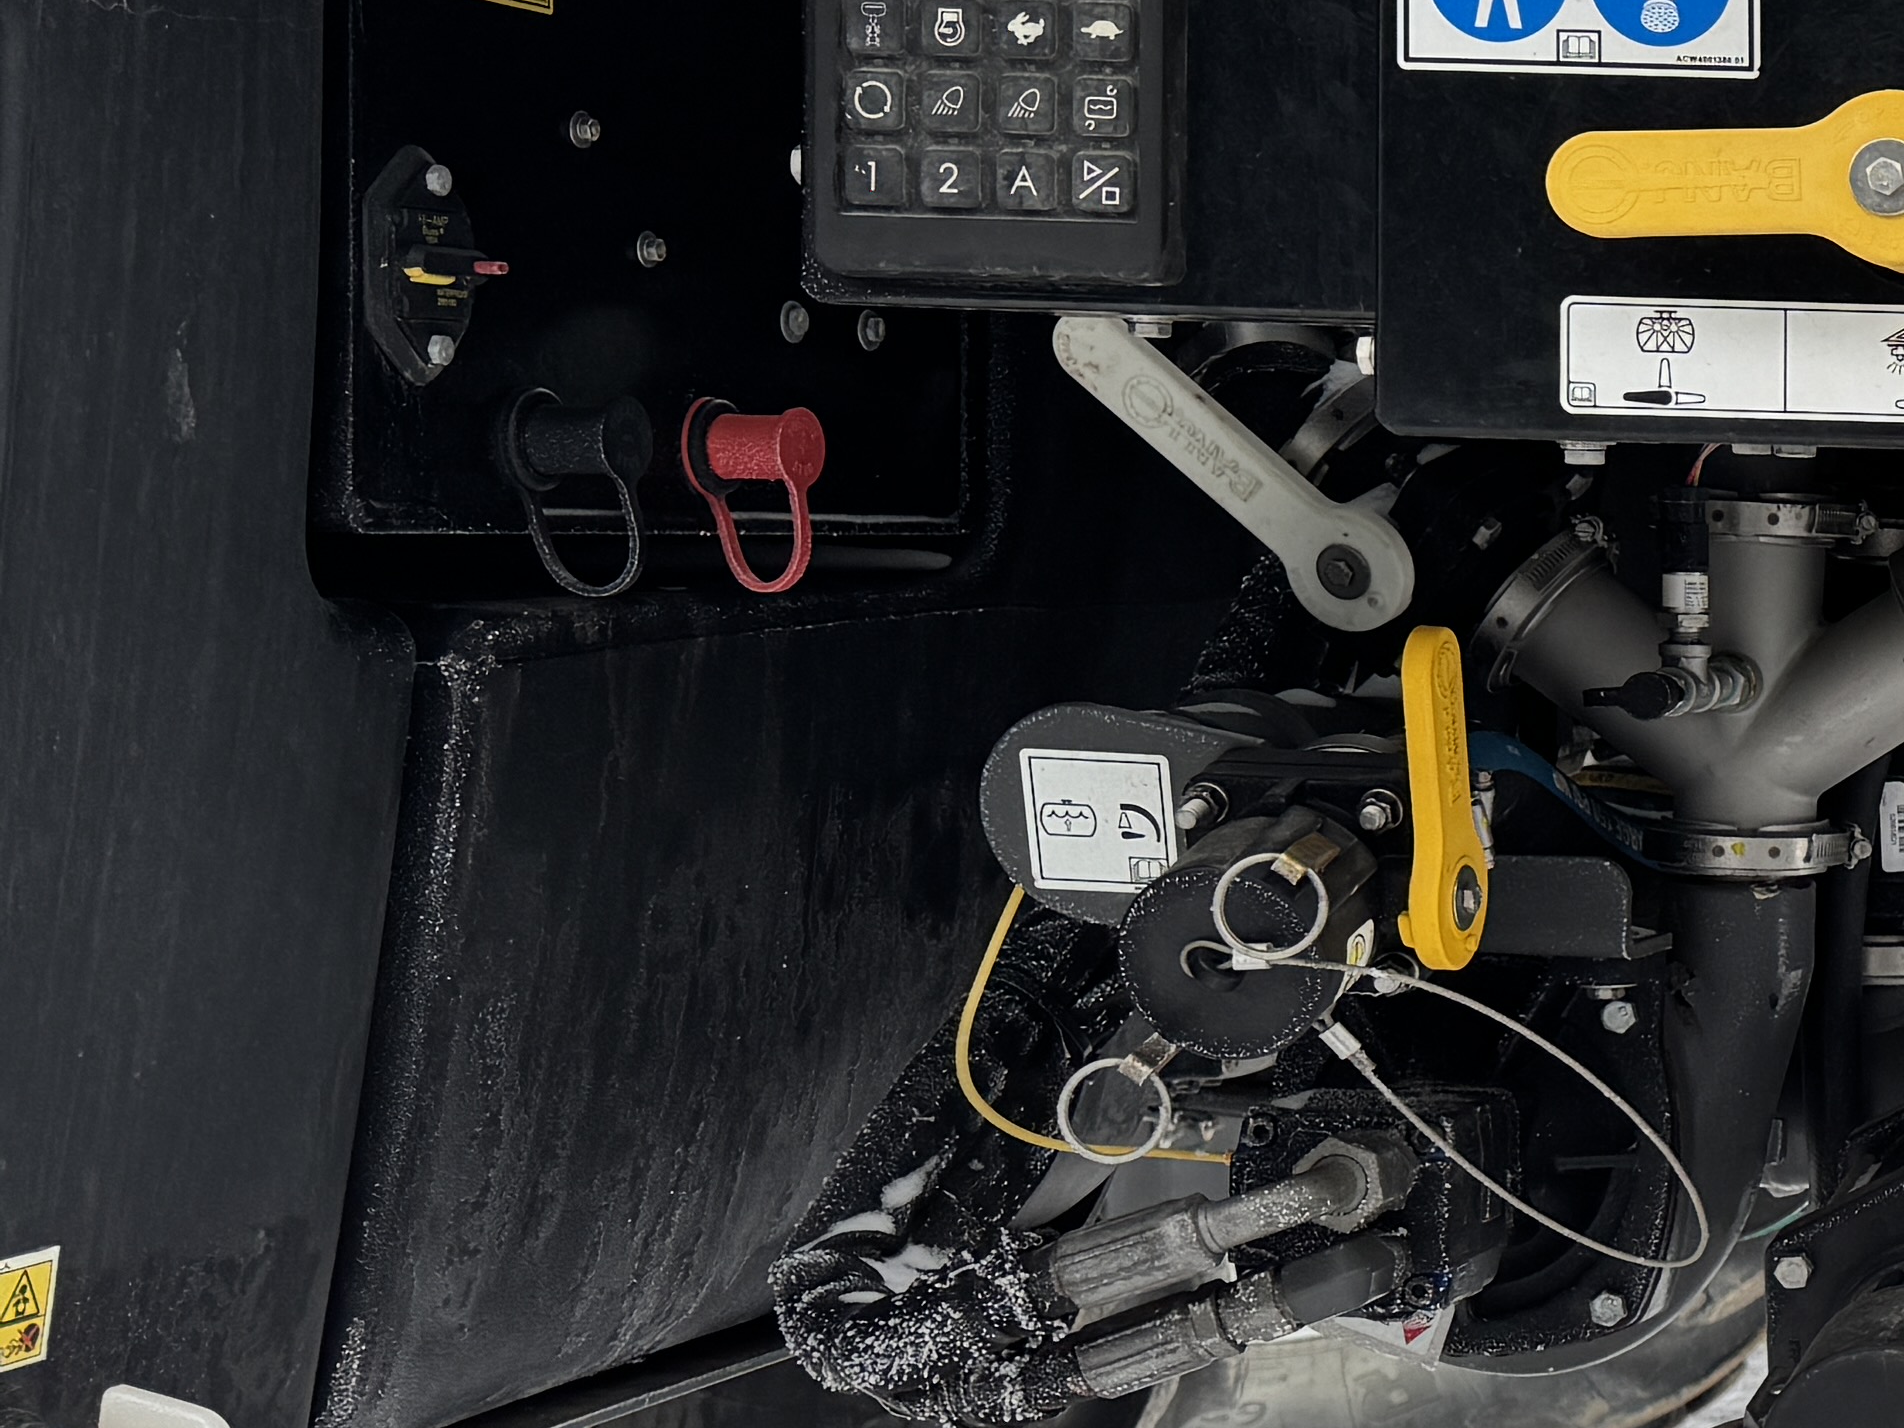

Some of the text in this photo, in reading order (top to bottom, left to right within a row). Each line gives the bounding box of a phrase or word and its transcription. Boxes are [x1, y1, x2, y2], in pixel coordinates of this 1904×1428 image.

[867, 160, 1038, 196] 1 2 A
